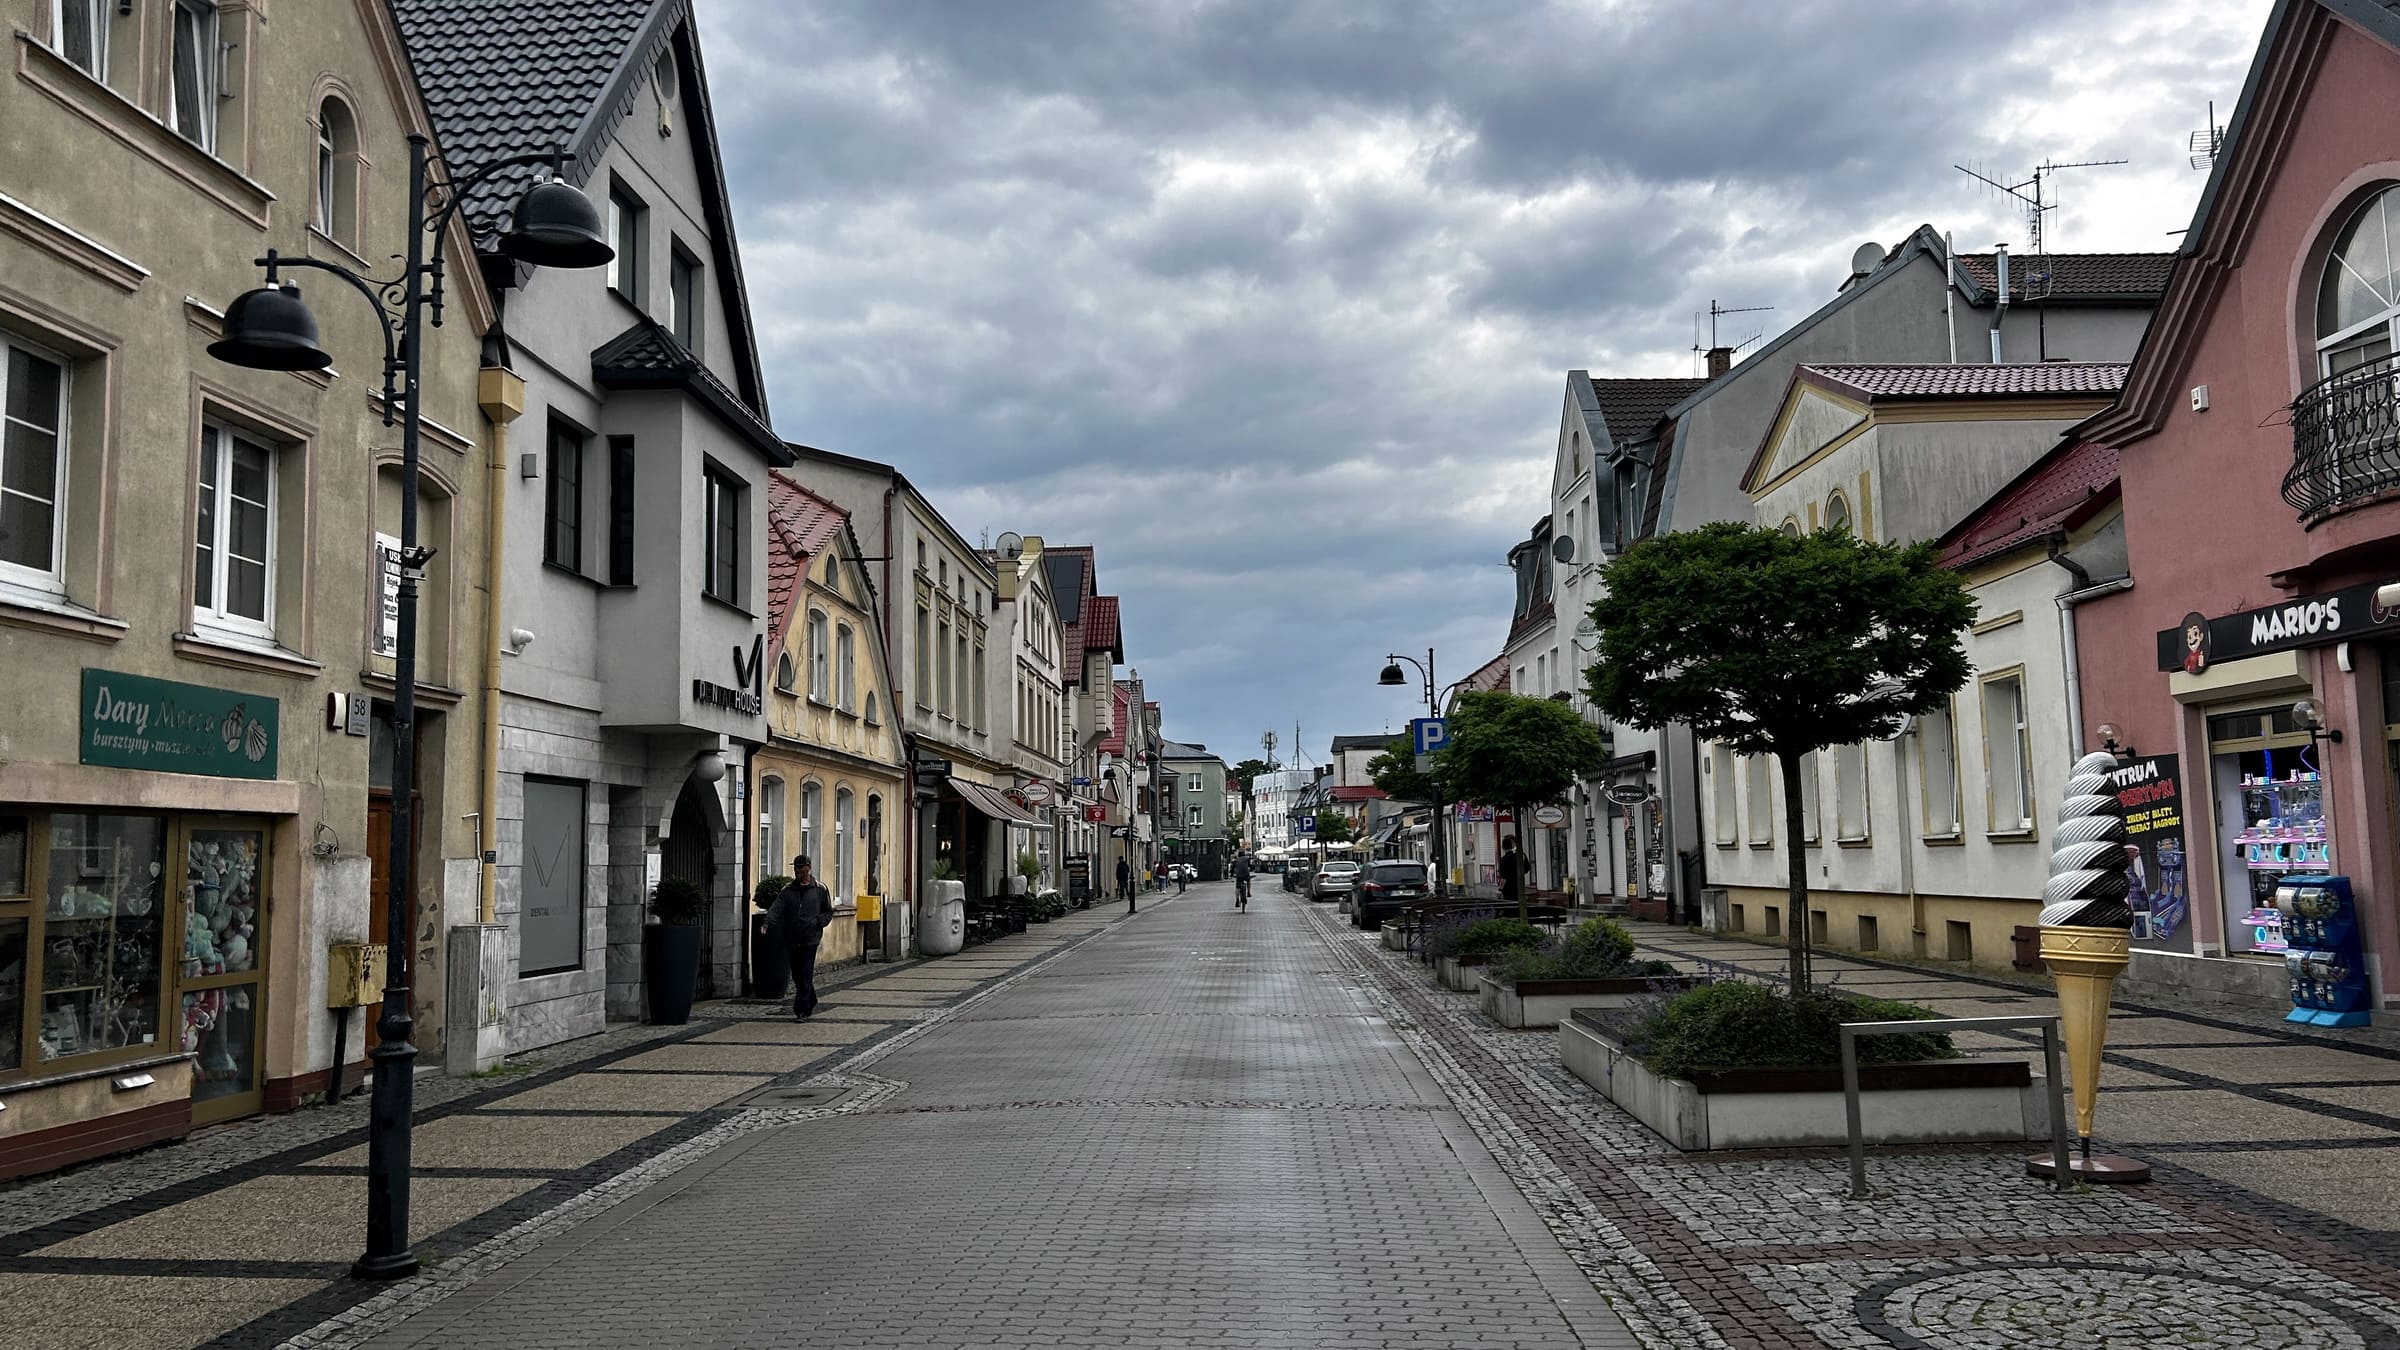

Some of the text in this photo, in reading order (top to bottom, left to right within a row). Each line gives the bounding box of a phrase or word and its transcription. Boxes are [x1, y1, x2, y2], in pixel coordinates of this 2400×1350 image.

[2251, 597, 2341, 646] MARIO'S
[94, 686, 150, 735] Dary
[354, 698, 366, 716] 58
[735, 690, 761, 715] HOUSE
[93, 727, 149, 755] bursztyny
[1422, 722, 1444, 751] P
[2106, 760, 2159, 788] NTRUM
[2117, 778, 2176, 808] OZRYWKI
[1112, 826, 1129, 837] 4F
[1303, 817, 1313, 831] P
